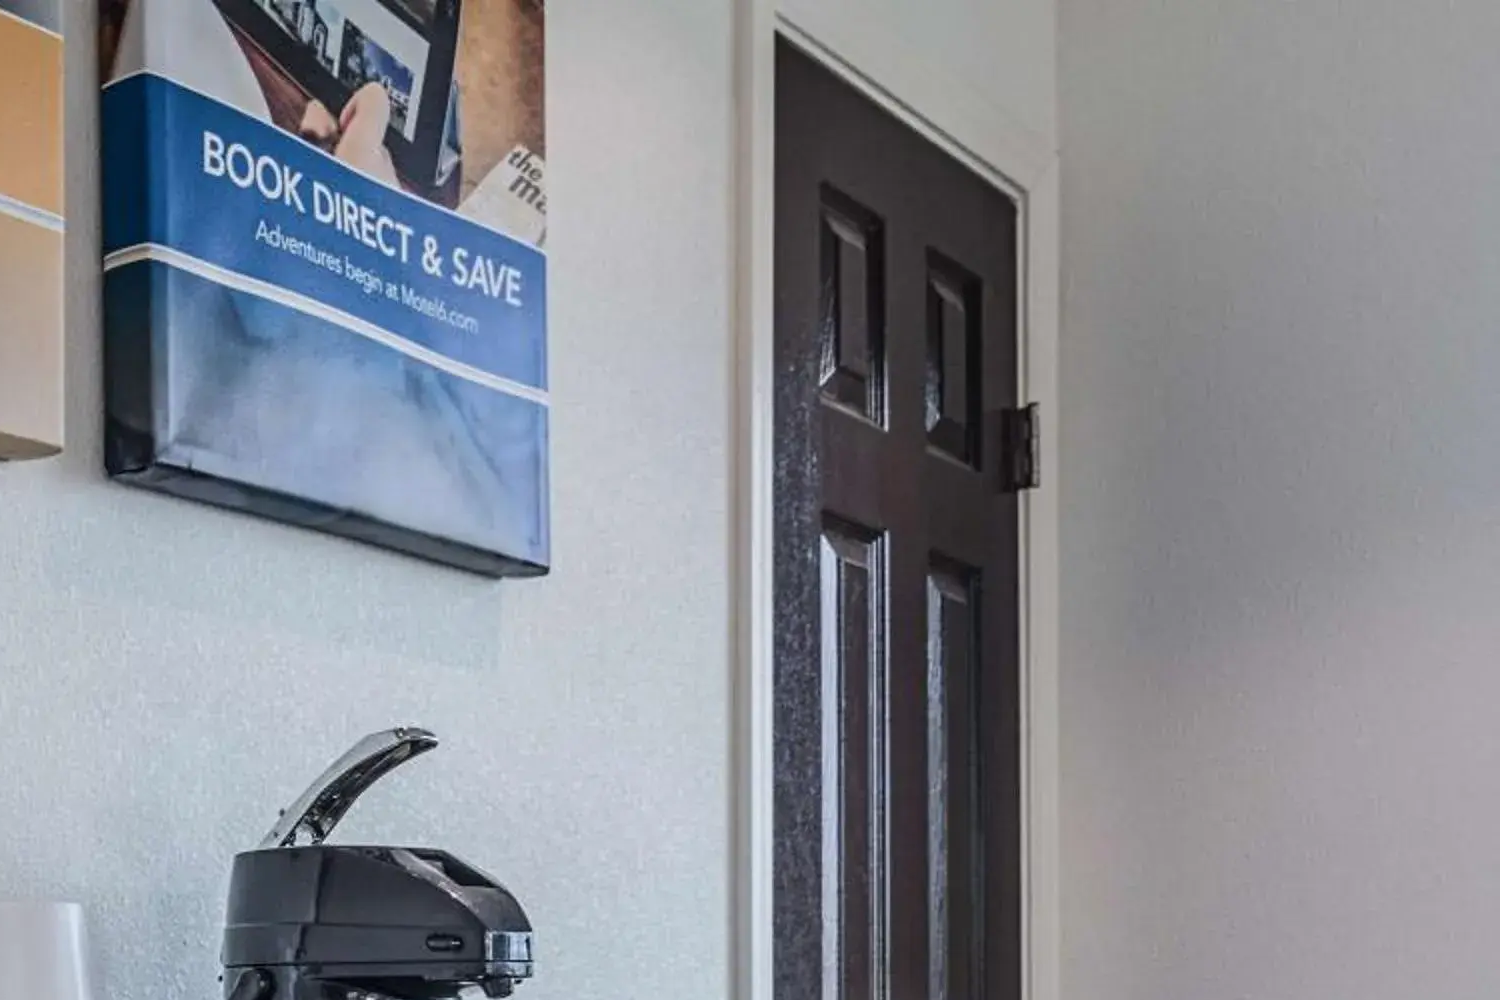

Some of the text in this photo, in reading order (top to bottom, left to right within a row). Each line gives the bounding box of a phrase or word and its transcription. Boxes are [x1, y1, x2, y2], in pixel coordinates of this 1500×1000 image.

[203, 130, 523, 308] BOOK DIRECT & SAVE
[507, 150, 543, 181] the
[255, 219, 479, 335] Adventures begin at Motel6.com
